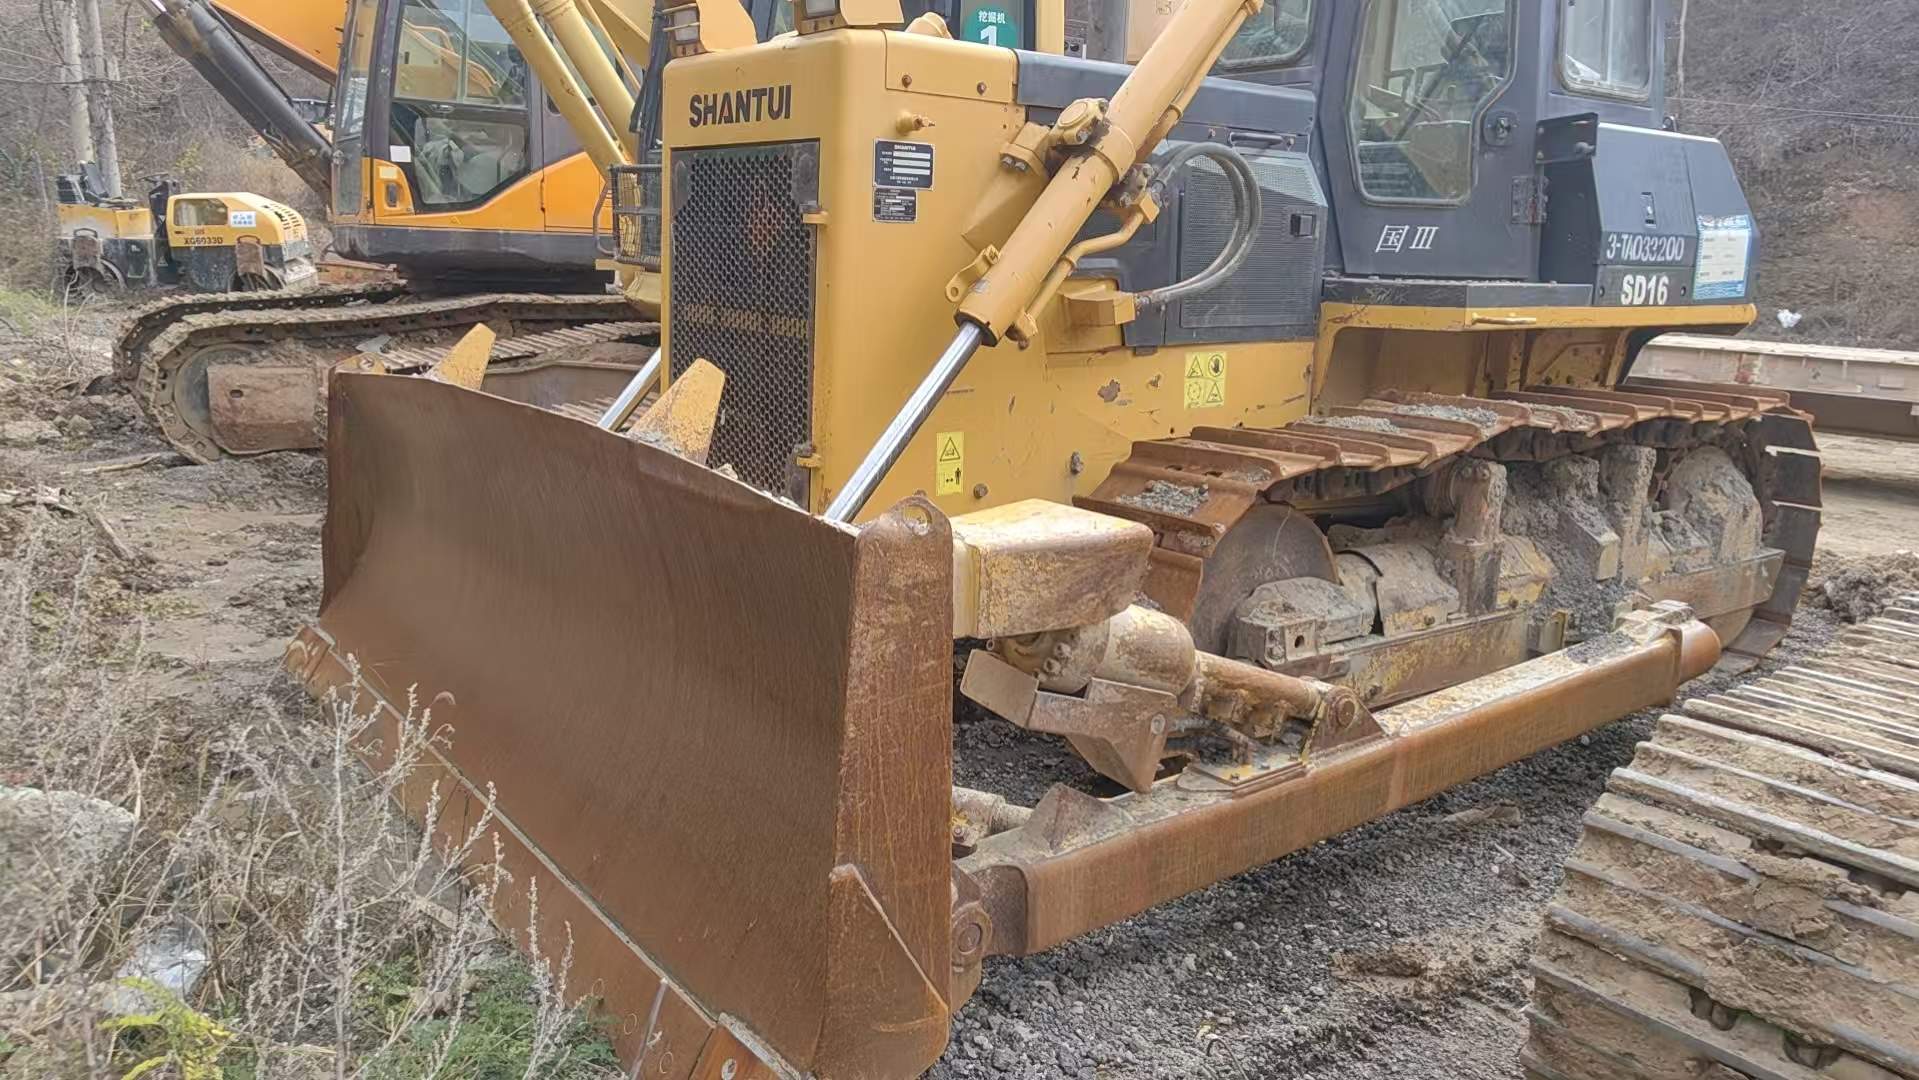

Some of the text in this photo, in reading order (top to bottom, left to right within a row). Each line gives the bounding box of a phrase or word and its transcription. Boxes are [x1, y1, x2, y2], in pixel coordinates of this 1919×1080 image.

[978, 10, 1006, 24] 挖掘机
[980, 25, 997, 46] 1
[689, 85, 792, 128] SHANTUI
[1375, 224, 1410, 253] 国
[1620, 274, 1669, 305] SD16
